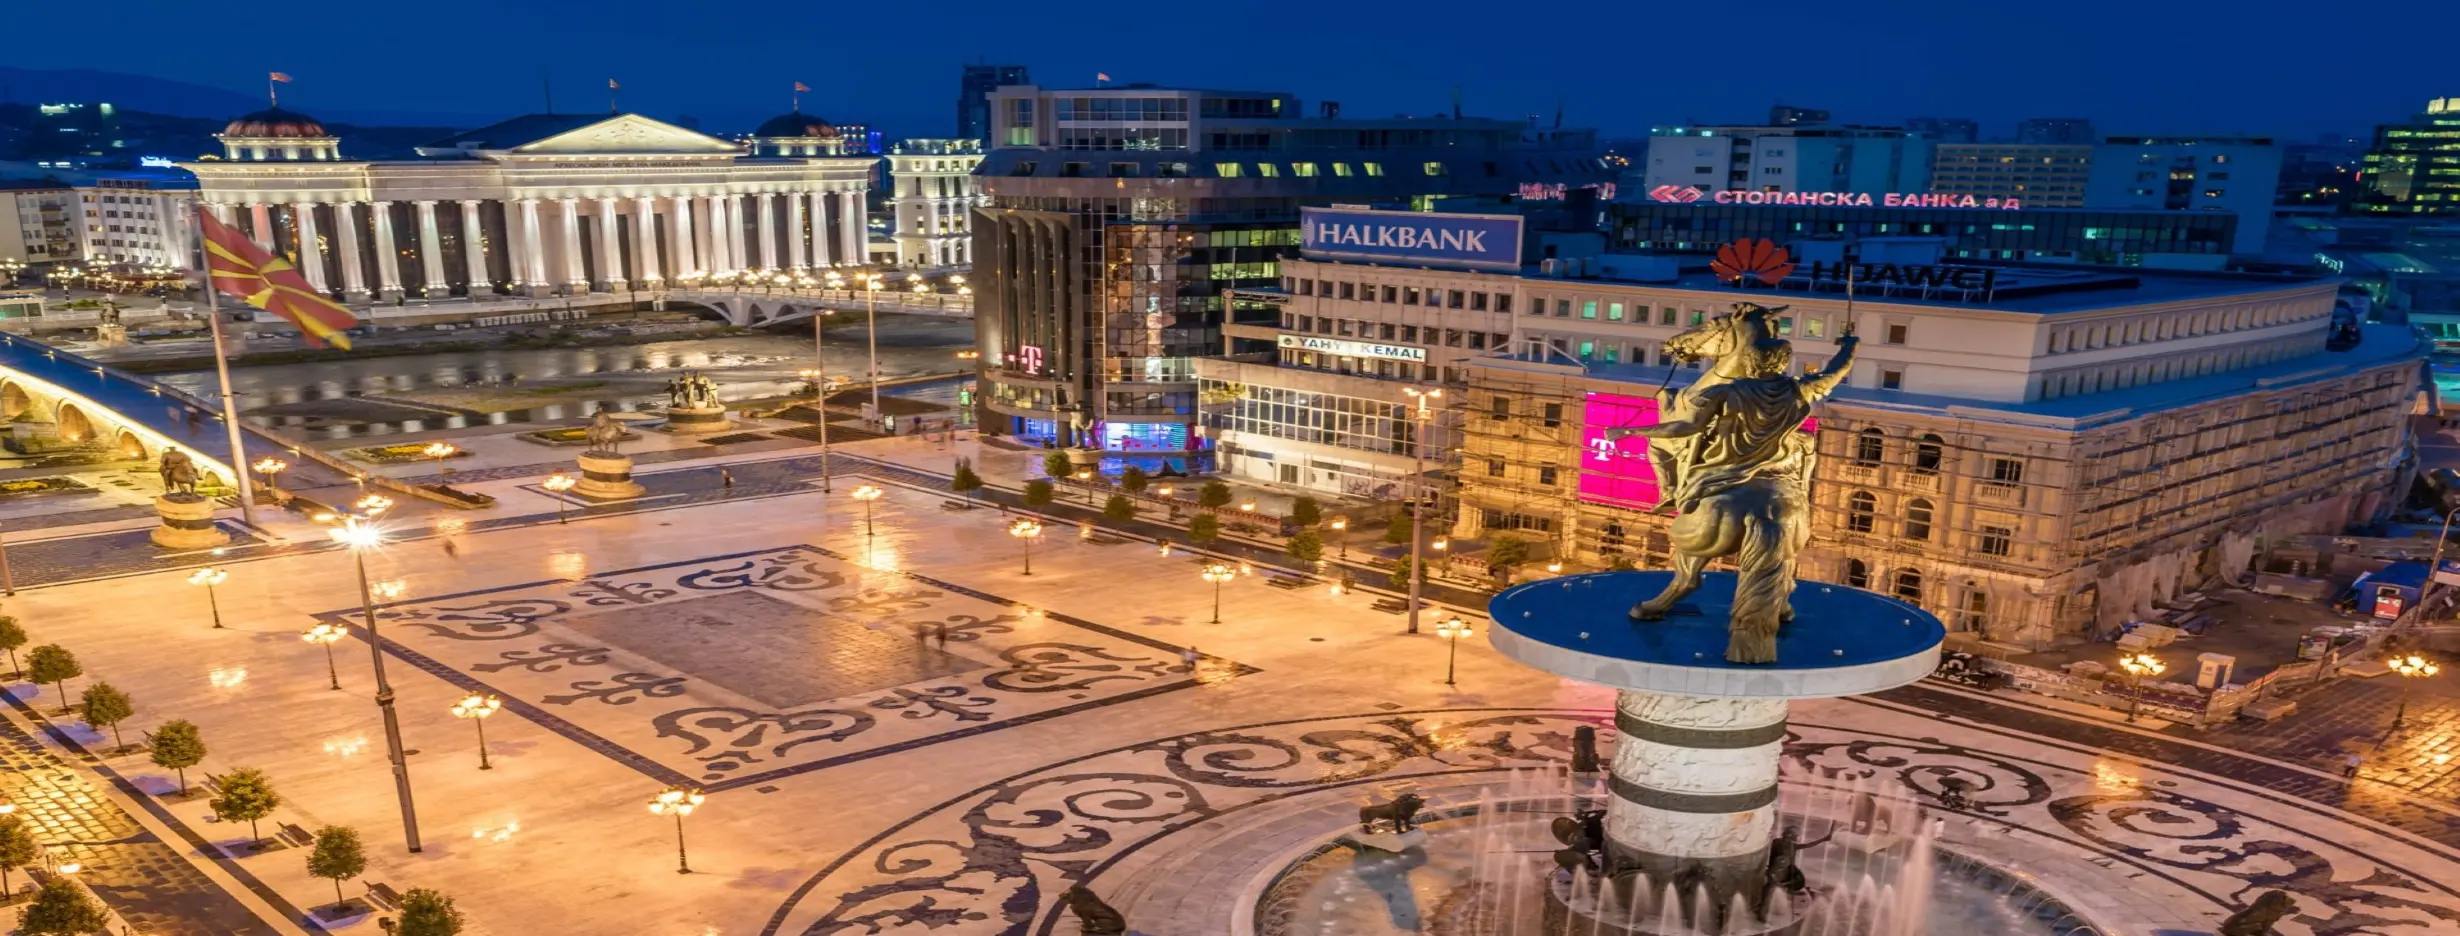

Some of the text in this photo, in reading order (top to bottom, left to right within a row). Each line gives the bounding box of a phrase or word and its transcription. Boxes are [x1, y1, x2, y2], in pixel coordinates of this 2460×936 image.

[1713, 190, 1873, 206] СТОПАНСКА
[1883, 192, 1977, 208] БАНКА
[1318, 222, 1487, 252] HALKBANK
[1812, 259, 1997, 291] HUAWEI
[1300, 337, 1423, 359] YAHY KEMAL
